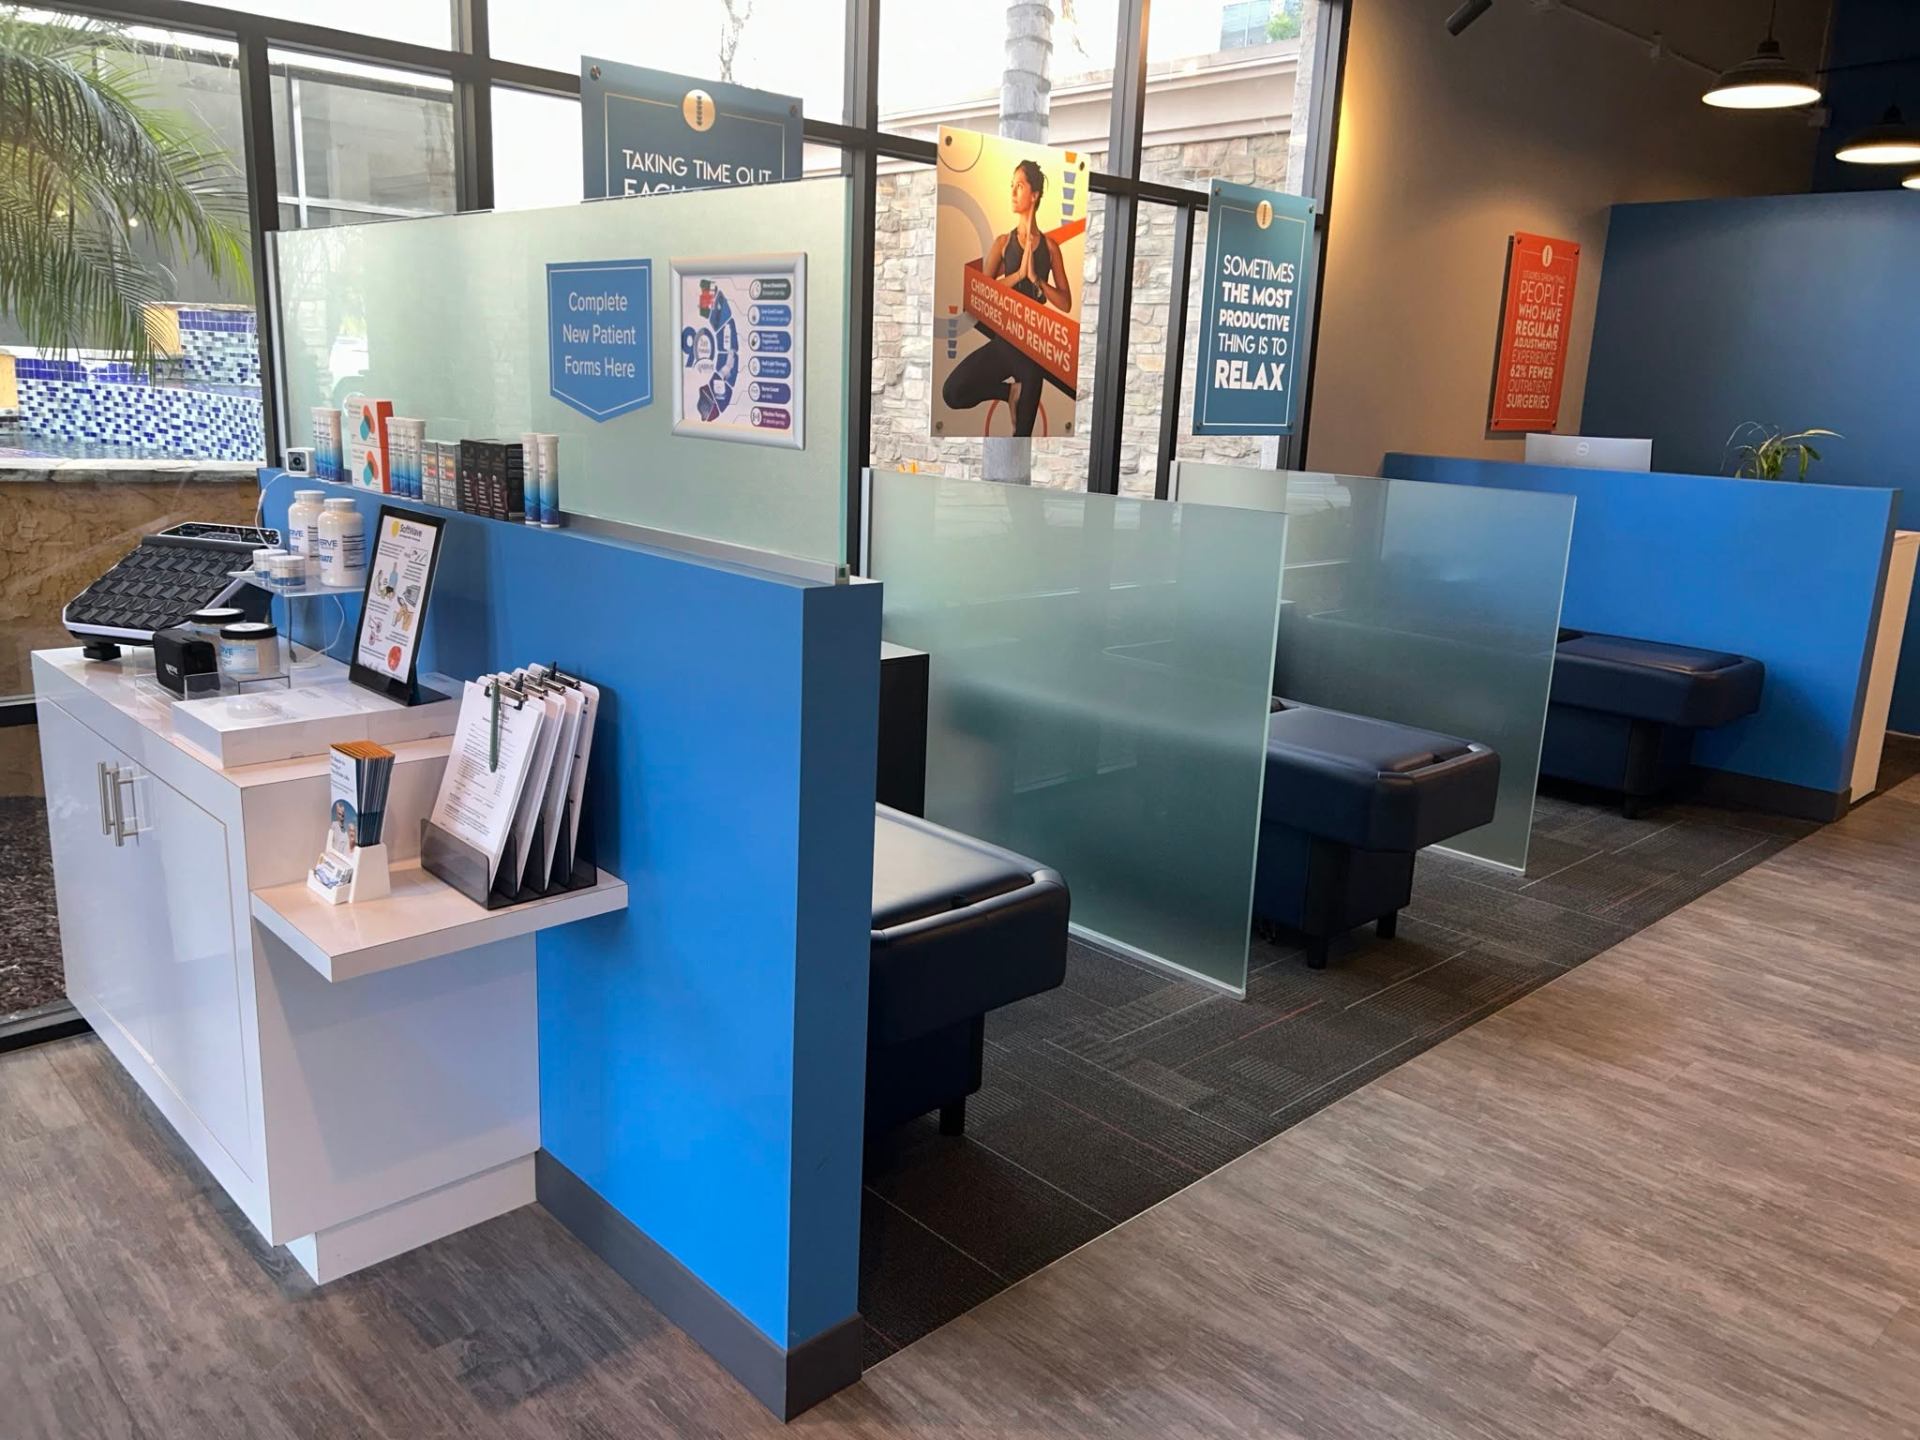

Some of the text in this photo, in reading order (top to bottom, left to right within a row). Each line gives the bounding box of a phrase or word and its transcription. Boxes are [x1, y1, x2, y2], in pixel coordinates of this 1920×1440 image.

[622, 149, 772, 184] TAKING TIME OUT
[1223, 254, 1295, 283] SOMETIMES
[568, 291, 628, 315] Complete
[1222, 281, 1293, 309] THE MOST
[1520, 279, 1565, 307] PEOPLE
[970, 278, 1072, 352] CHIROPRACTIC REVIVES,
[1219, 308, 1290, 333] PRODUCTIVE
[1518, 303, 1562, 322] WHO HAVE
[562, 323, 637, 345] New Patient
[970, 294, 1071, 372] RESTORES, AND RENEWS
[1515, 319, 1559, 340] REGULAR
[1218, 332, 1288, 356] THING IS TO
[1513, 336, 1558, 351] ADJUSTMENTS
[564, 355, 636, 378] Forms Here
[1511, 348, 1556, 366] EXPERIENCE
[1214, 359, 1286, 391] RELAX
[1510, 363, 1554, 380] 62% FEWER
[1505, 393, 1550, 409] SURGERIES
